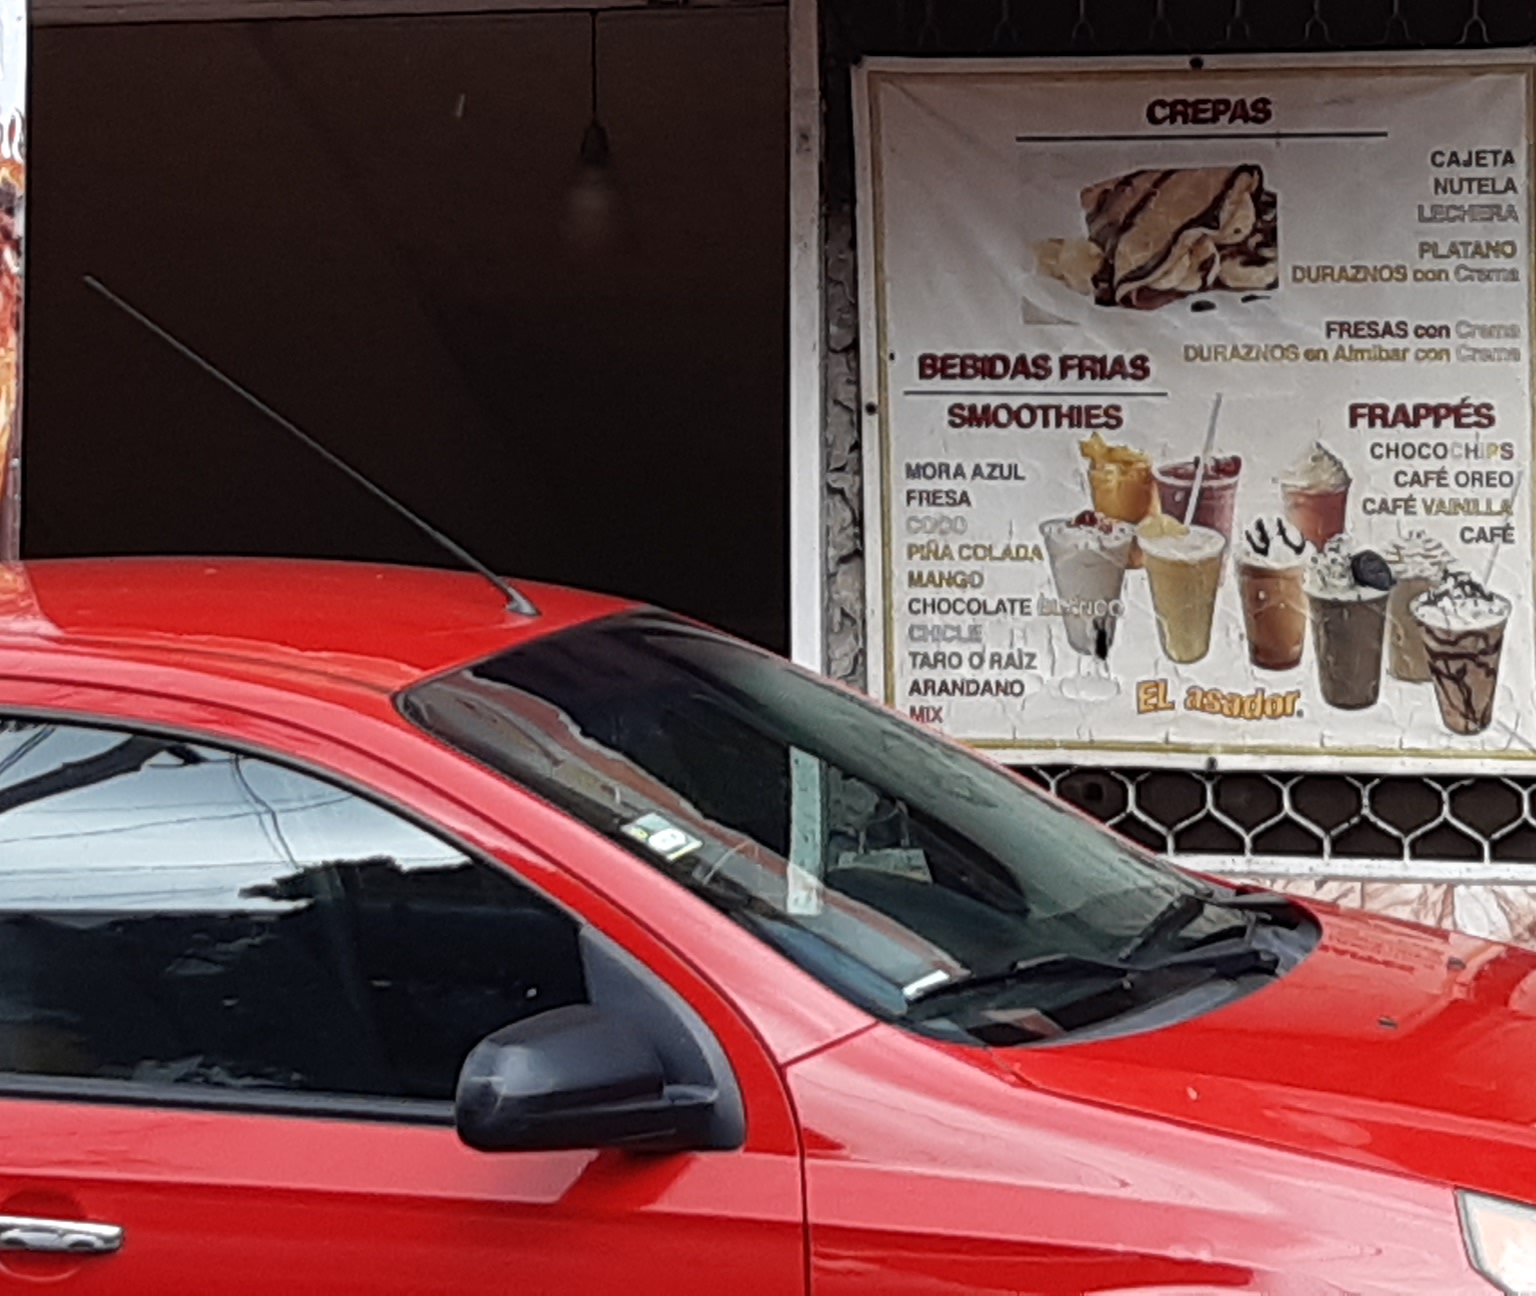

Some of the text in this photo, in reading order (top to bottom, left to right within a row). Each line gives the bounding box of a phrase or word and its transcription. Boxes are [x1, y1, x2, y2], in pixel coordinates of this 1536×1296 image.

[1146, 97, 1272, 125] CREPAS
[1430, 150, 1515, 168] CAJETA
[1433, 177, 1518, 195] NUTELA
[1417, 204, 1519, 223] LECHERA
[1418, 241, 1517, 259] PLATANO
[1291, 264, 1520, 283] DURAZNOS con Crema
[1325, 320, 1520, 339] FRESAS con Crema
[1184, 344, 1299, 362] DURAZNOS
[1304, 348, 1328, 362] en
[1414, 347, 1451, 361] con
[1456, 344, 1520, 362] Crema
[918, 354, 1151, 381] BEBIDAS FRIAS
[947, 403, 1123, 429] SMOOTHIES
[1349, 396, 1495, 429] FRAPPÉS
[905, 462, 1025, 480] MORA AZUL
[1394, 465, 1513, 488] CAFÉ OREO
[906, 489, 971, 507] FRESA
[1362, 494, 1417, 515] CAFÉ
[906, 516, 967, 535] COCO
[1460, 523, 1515, 544] CAFÉ
[907, 539, 1044, 561] PIÑA COLADA
[908, 570, 985, 588] MANGO
[908, 598, 1032, 615] CHOCOLATE
[908, 624, 983, 643] CHICLE
[909, 651, 962, 670] TARO
[908, 679, 1025, 697] ARANDANO
[1137, 678, 1300, 720] EL asador
[910, 705, 944, 724] MIX
